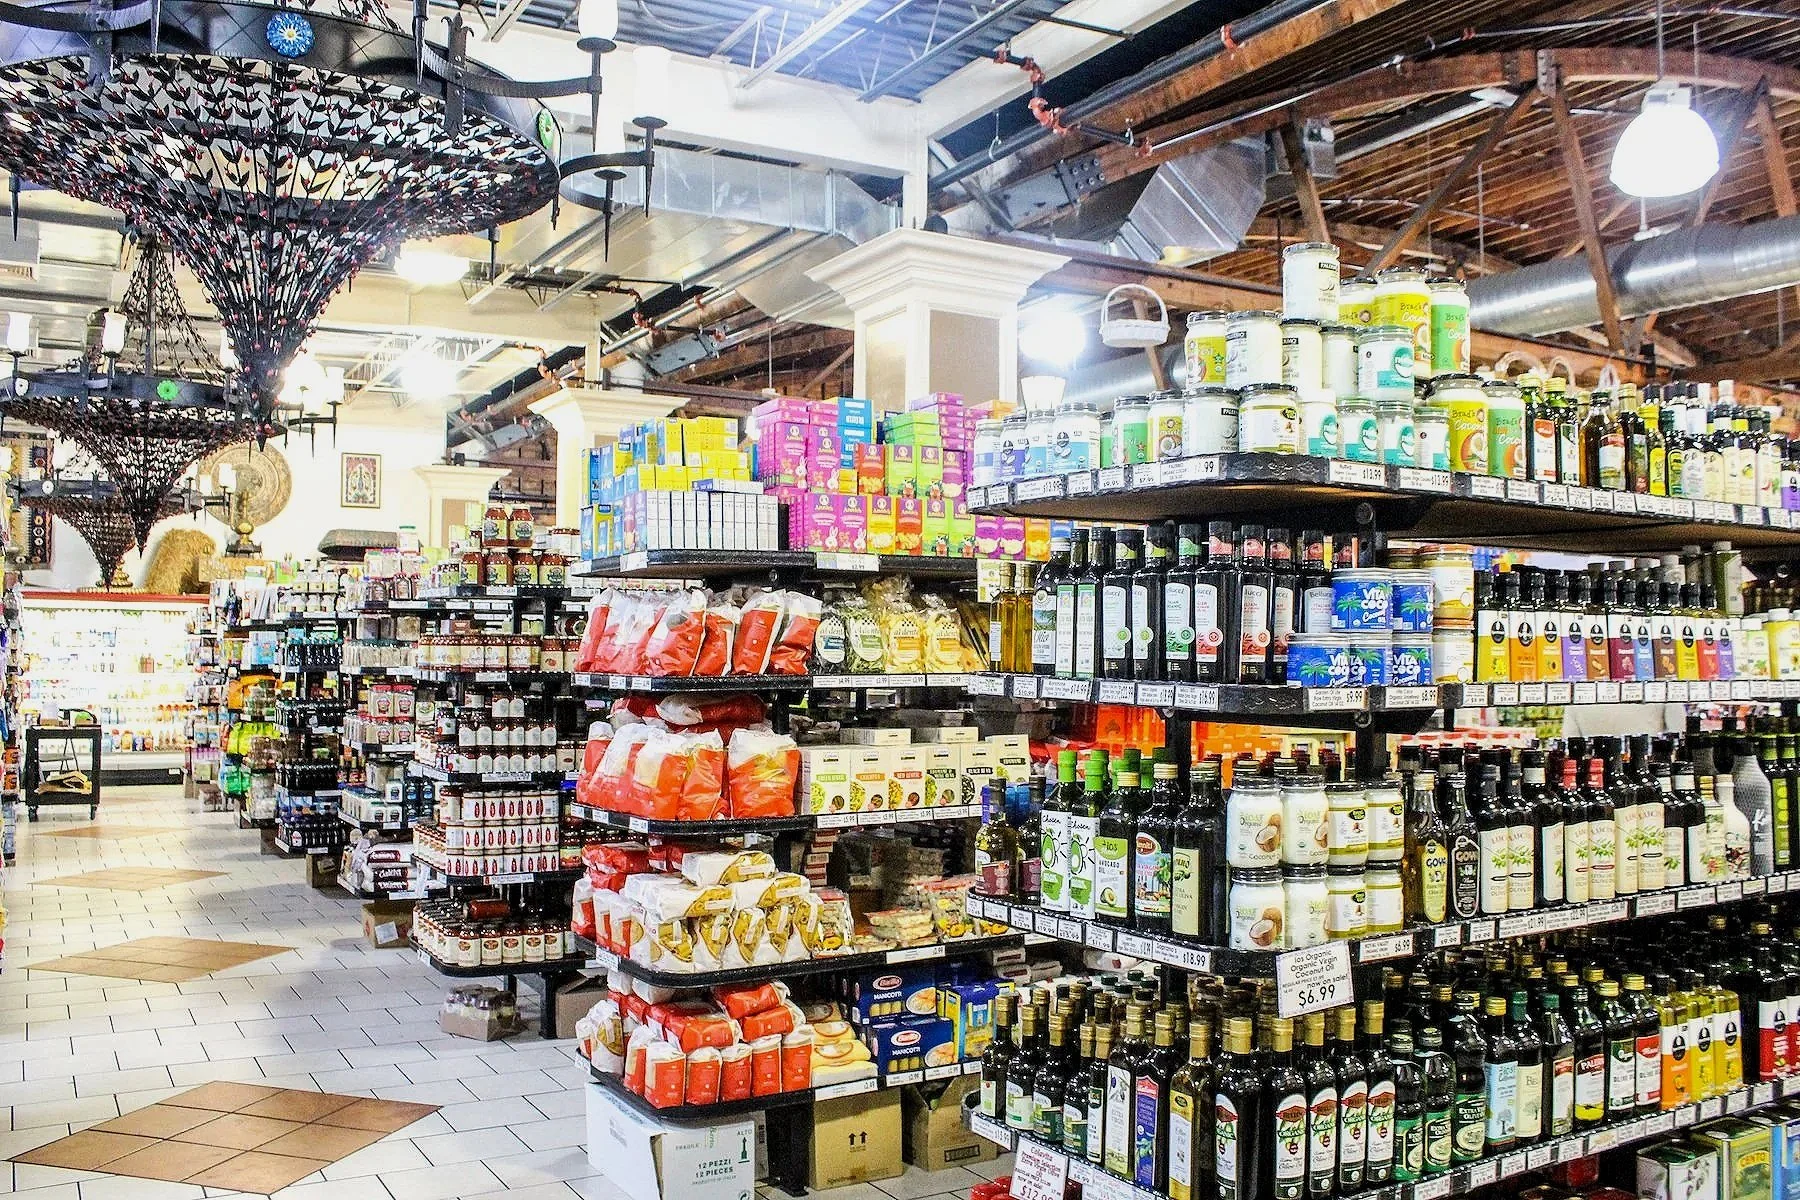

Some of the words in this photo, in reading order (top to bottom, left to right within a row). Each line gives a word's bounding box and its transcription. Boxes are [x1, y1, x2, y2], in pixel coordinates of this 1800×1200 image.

[1362, 468, 1382, 480] $13.99
[1362, 587, 1386, 600] VITA
[1361, 599, 1388, 610] COCO
[1393, 653, 1418, 666] VITA
[1392, 665, 1421, 676] COCO
[1347, 690, 1363, 703] $9.99
[1422, 690, 1436, 702] $8.99
[1042, 815, 1061, 824] Chosen
[1070, 821, 1090, 831] Chosen
[1426, 858, 1446, 867] GOYA
[1183, 951, 1206, 966] $18.99
[1306, 950, 1332, 961] Organic
[1291, 961, 1317, 972] Organic
[1319, 956, 1338, 965] Virgin
[1295, 966, 1324, 979] Coconut
[1326, 963, 1334, 971] Oil
[873, 991, 902, 1000] MANICOTTI
[1299, 984, 1335, 1008] $6.99
[892, 1047, 921, 1056] MANICOTTI
[1030, 1146, 1053, 1161] Colavita
[698, 1161, 707, 1169] 12
[709, 1158, 731, 1168] PEZZI
[1021, 1151, 1040, 1164] Premium
[1041, 1158, 1061, 1173] Selection
[1021, 1158, 1032, 1167] Extra
[1740, 1153, 1765, 1167] CENTO
[696, 1170, 704, 1178] 12
[706, 1166, 733, 1176] PIECES
[1017, 1175, 1026, 1183] now
